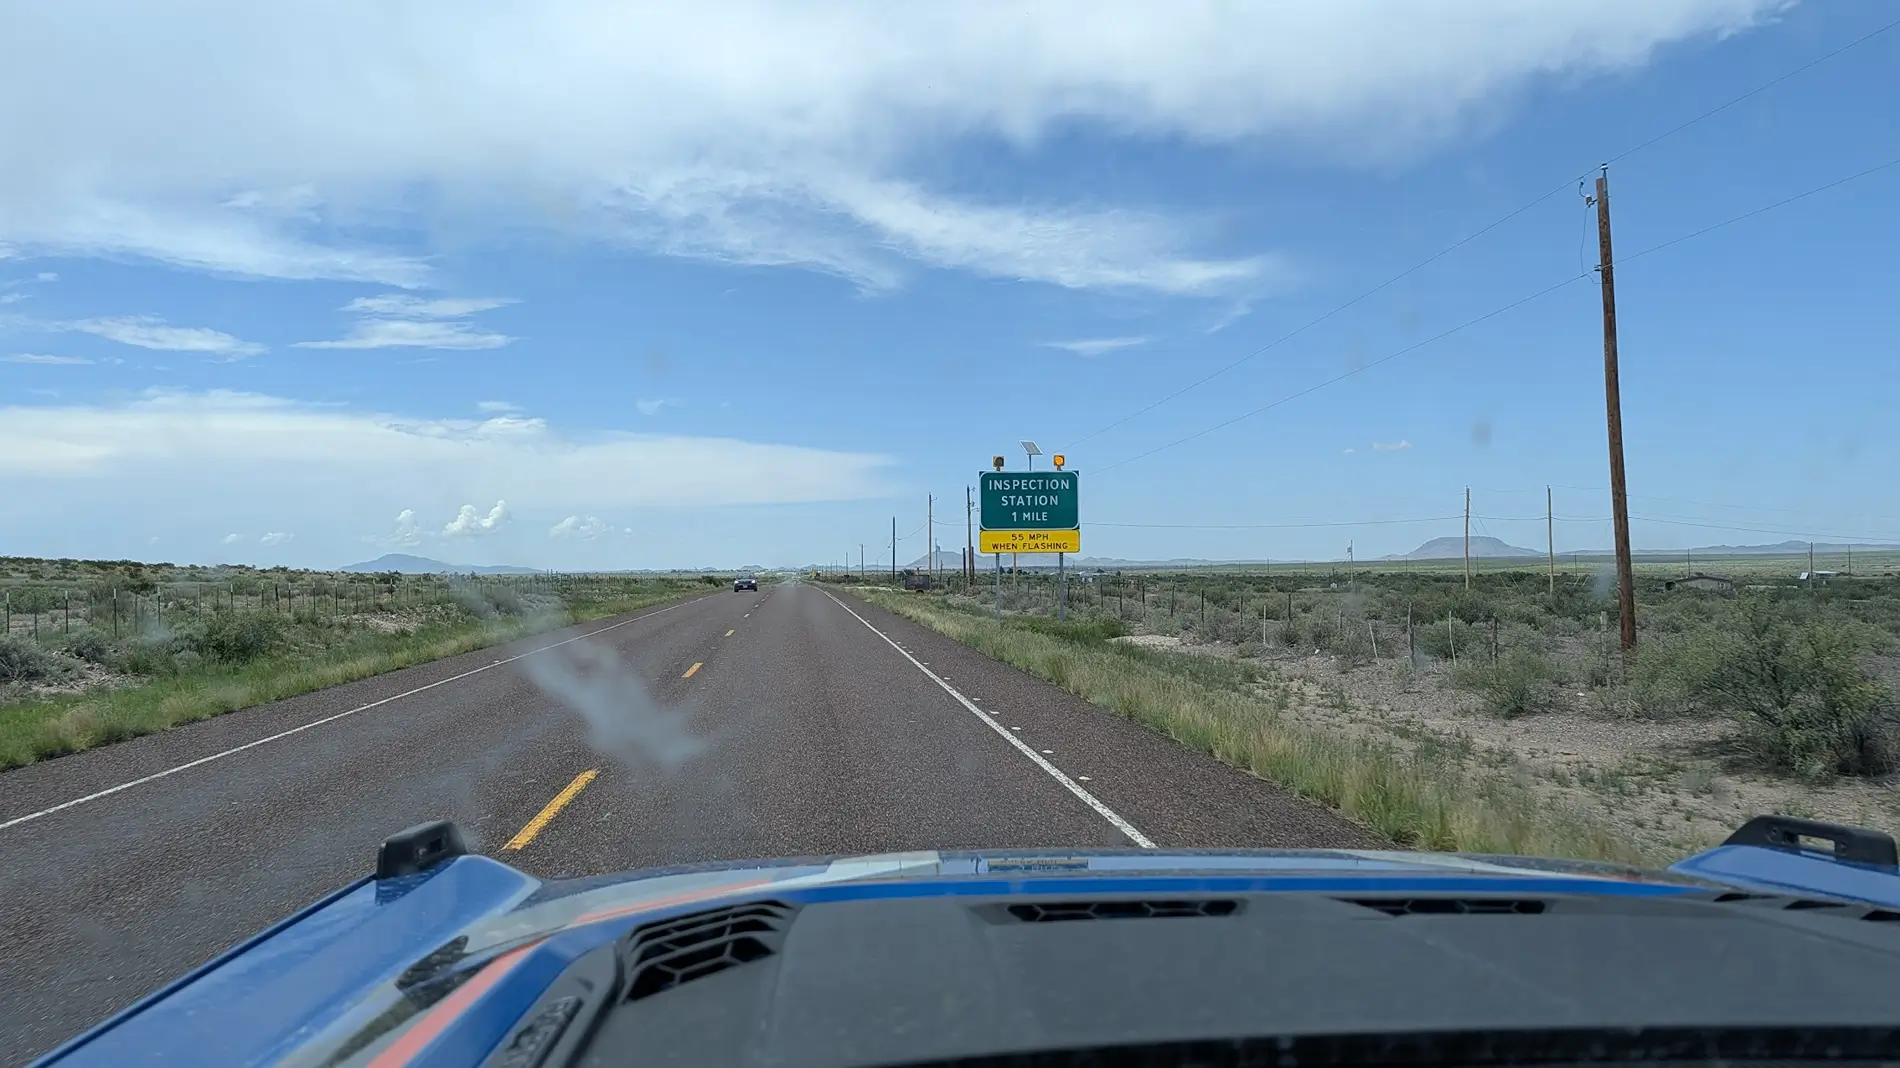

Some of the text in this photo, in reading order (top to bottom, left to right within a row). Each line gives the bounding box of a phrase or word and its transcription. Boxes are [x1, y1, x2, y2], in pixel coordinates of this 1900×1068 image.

[989, 479, 1070, 490] INSPECTION
[1001, 495, 1059, 506] STATION
[1012, 512, 1048, 522] 1 MILE
[1022, 542, 1068, 550] FLASHING
